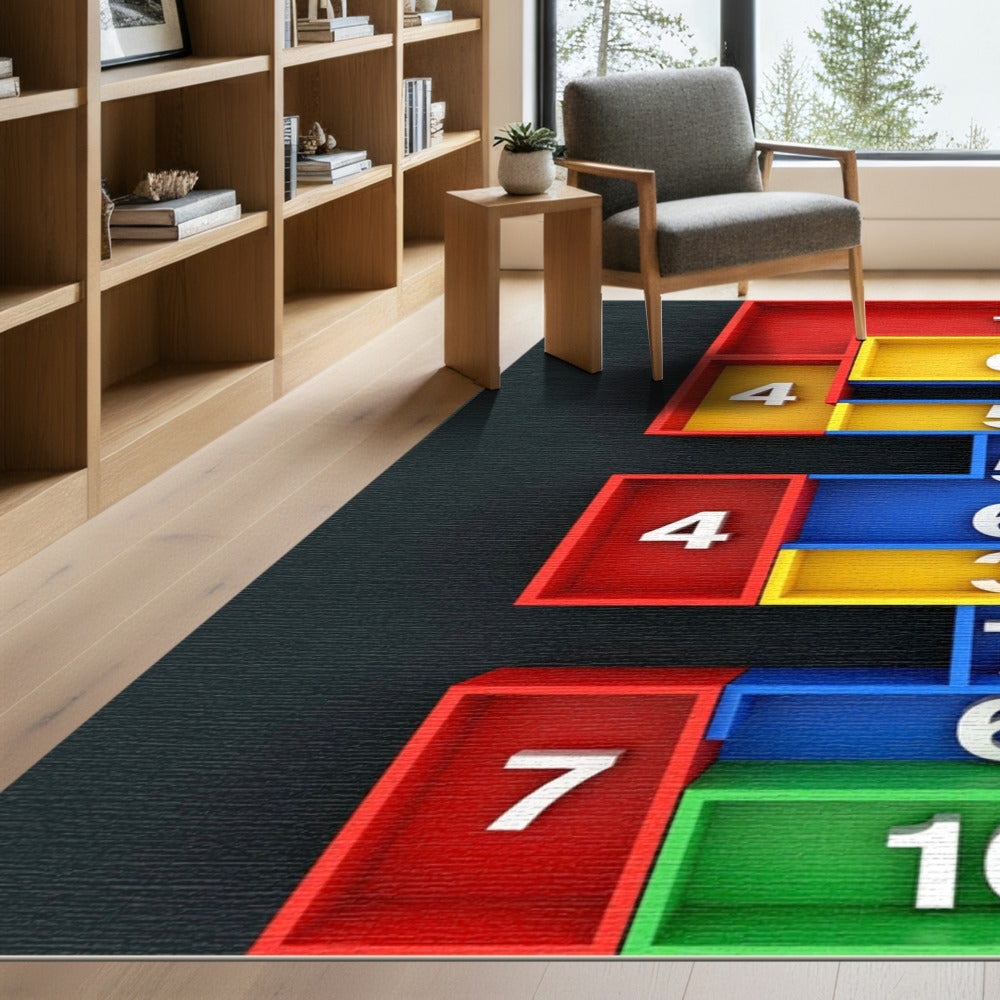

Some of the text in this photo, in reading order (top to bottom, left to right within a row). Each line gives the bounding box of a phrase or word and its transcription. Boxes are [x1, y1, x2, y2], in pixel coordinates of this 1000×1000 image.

[729, 382, 797, 406] 4
[639, 511, 729, 549] 4
[486, 750, 626, 832] 7
